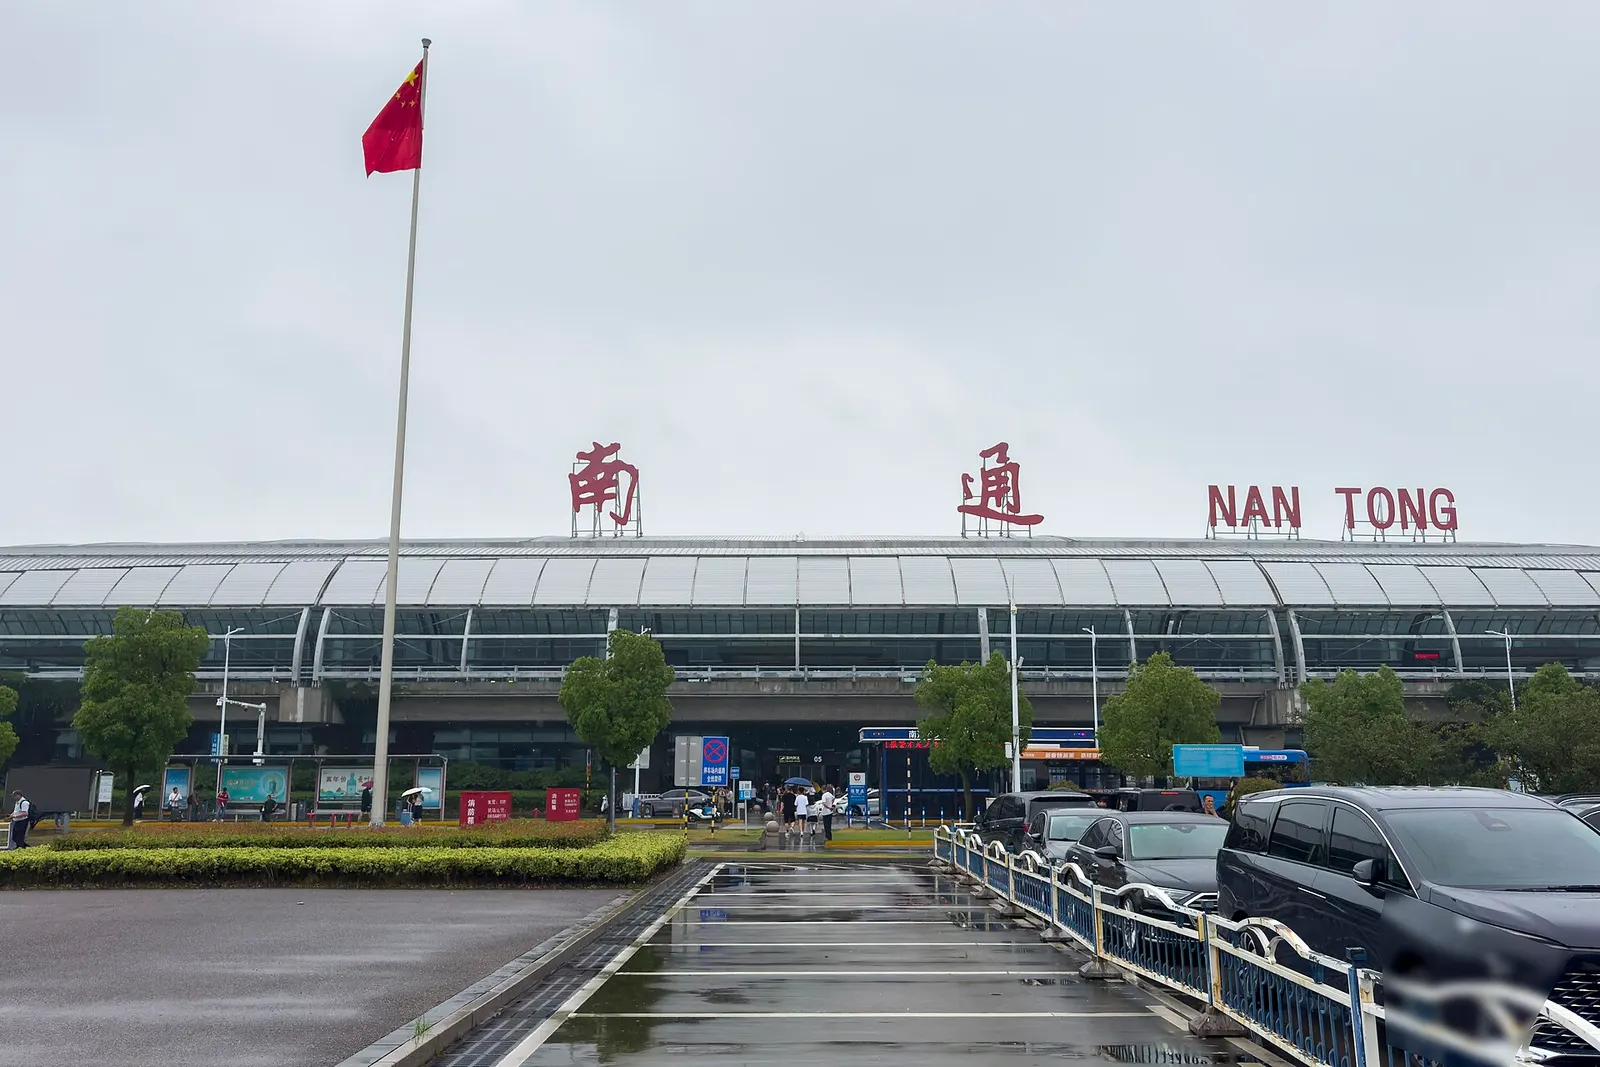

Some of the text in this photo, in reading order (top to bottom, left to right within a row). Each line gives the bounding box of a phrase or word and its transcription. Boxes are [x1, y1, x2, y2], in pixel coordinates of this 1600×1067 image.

[568, 441, 1045, 526] 南 通
[1207, 484, 1459, 531] NAN TONG
